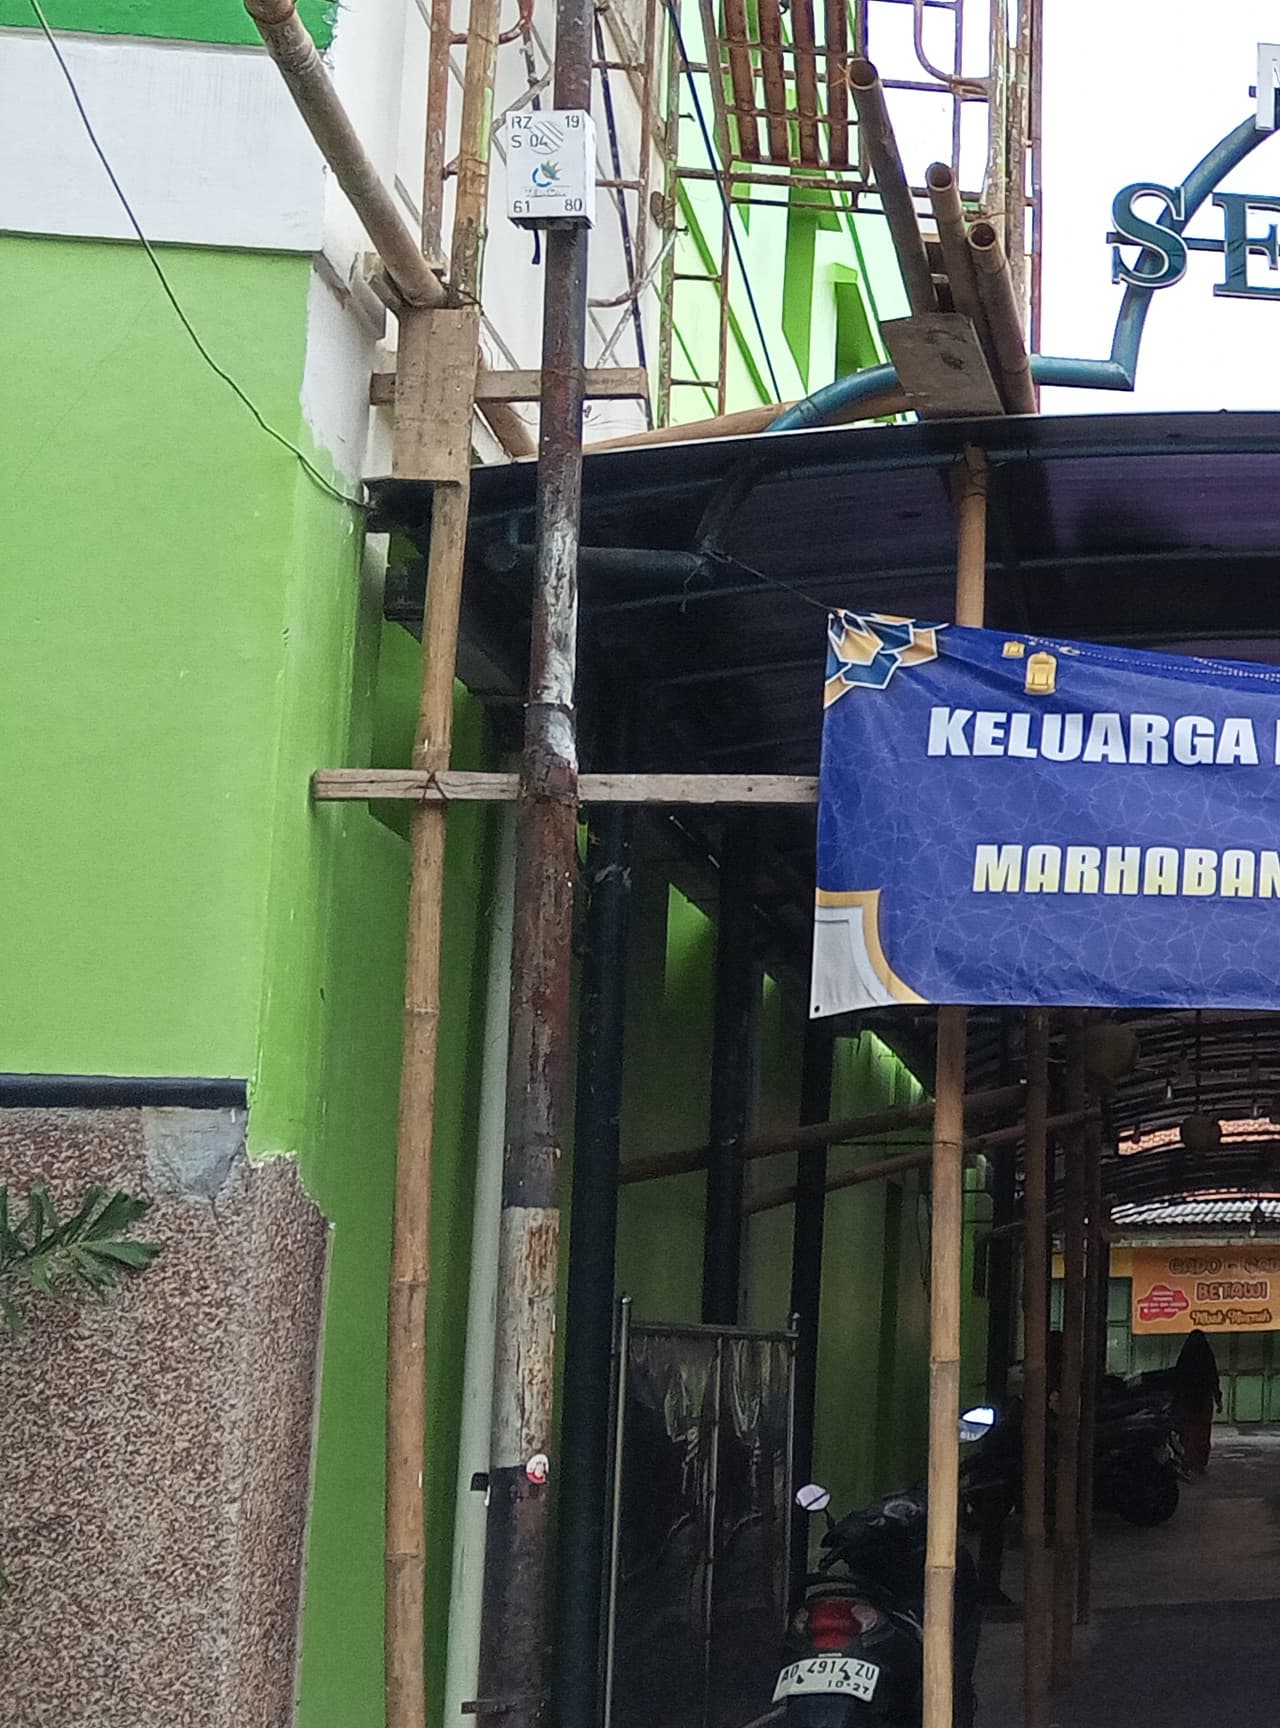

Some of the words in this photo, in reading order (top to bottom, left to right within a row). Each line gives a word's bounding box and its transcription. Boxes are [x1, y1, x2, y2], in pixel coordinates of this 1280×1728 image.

[564, 114, 581, 129] 19
[511, 134, 522, 149] S
[513, 199, 531, 213] 61
[564, 198, 583, 212] 80
[926, 706, 1259, 766] KELUARGA
[1196, 1281, 1270, 1301] BETAWI
[854, 1662, 876, 1681] ZU
